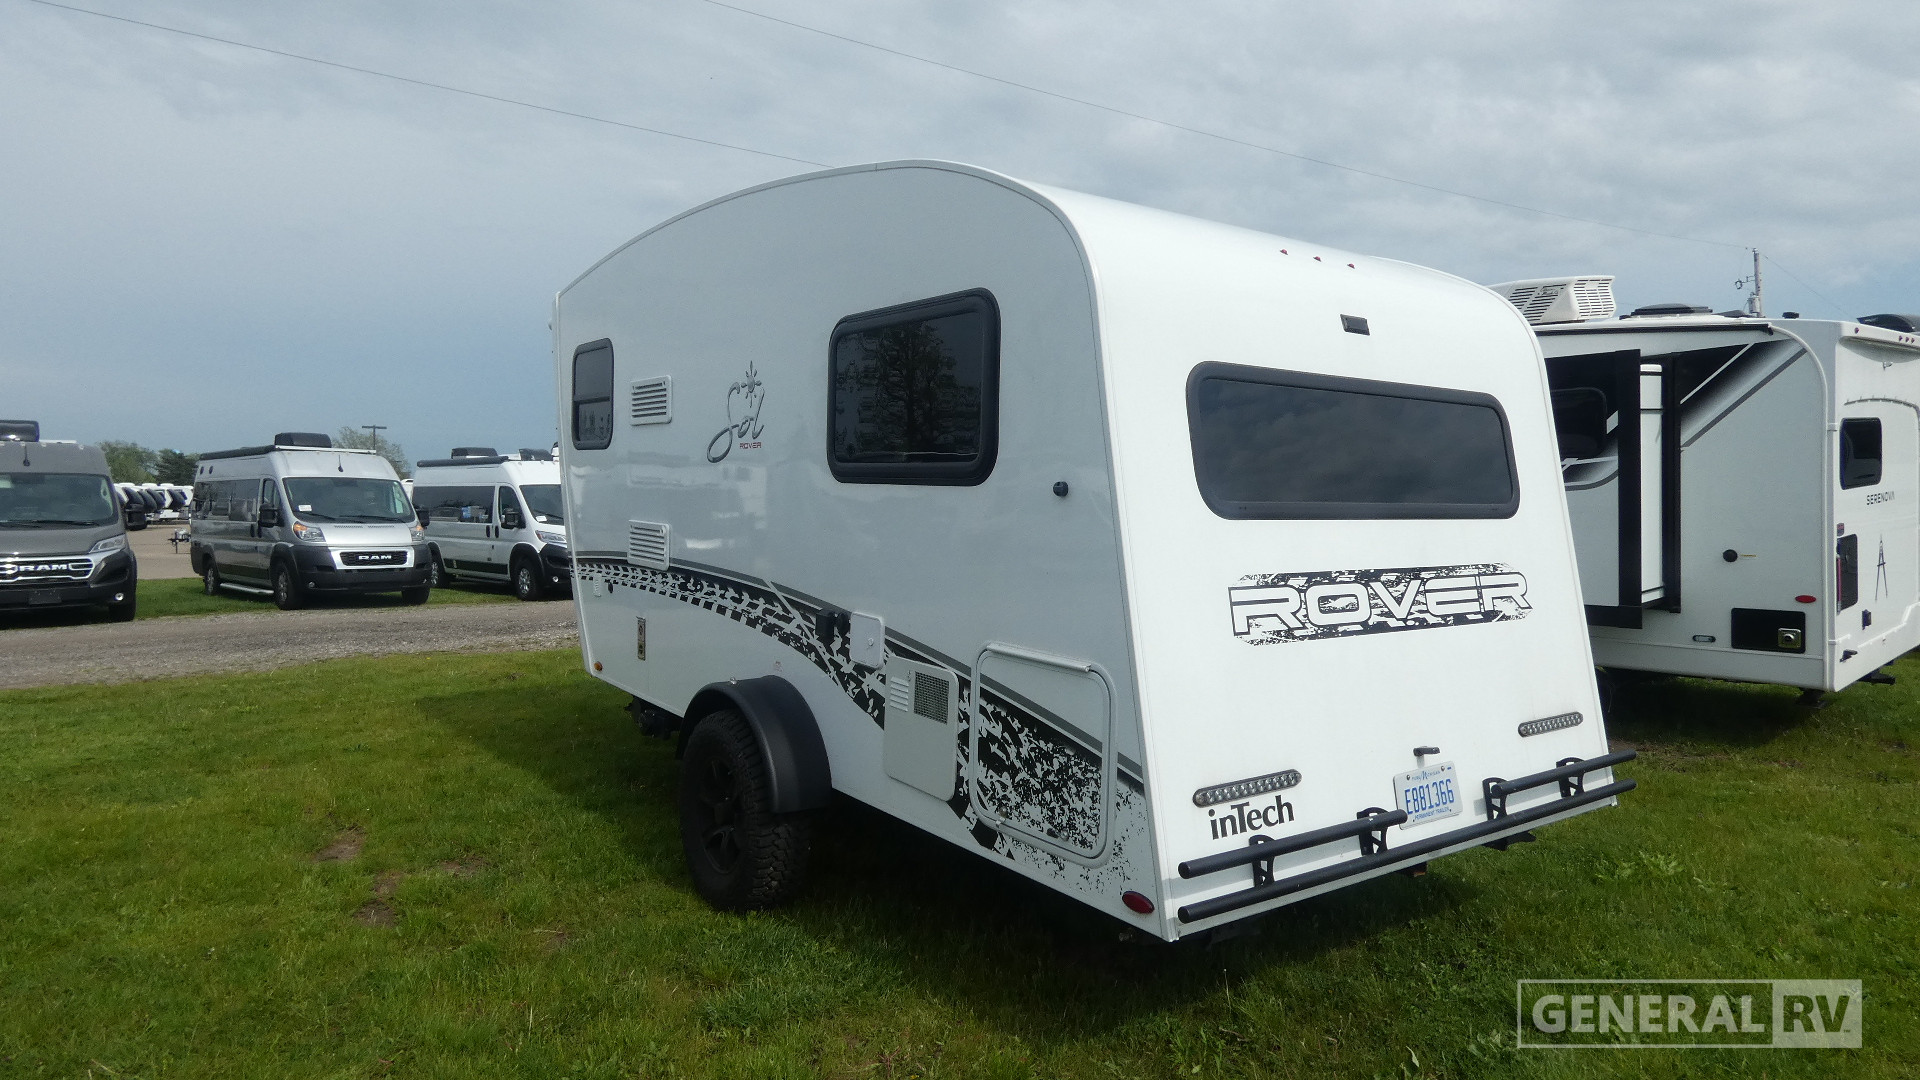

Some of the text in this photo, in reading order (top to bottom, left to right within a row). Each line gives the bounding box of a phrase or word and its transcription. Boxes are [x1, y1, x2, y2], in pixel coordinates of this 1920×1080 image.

[739, 441, 762, 450] ROVER
[1866, 490, 1896, 506] SERENOVA
[19, 564, 68, 572] RAM
[1228, 571, 1533, 638] ROVER
[1404, 778, 1455, 815] E881366
[1208, 795, 1295, 840] inTech
